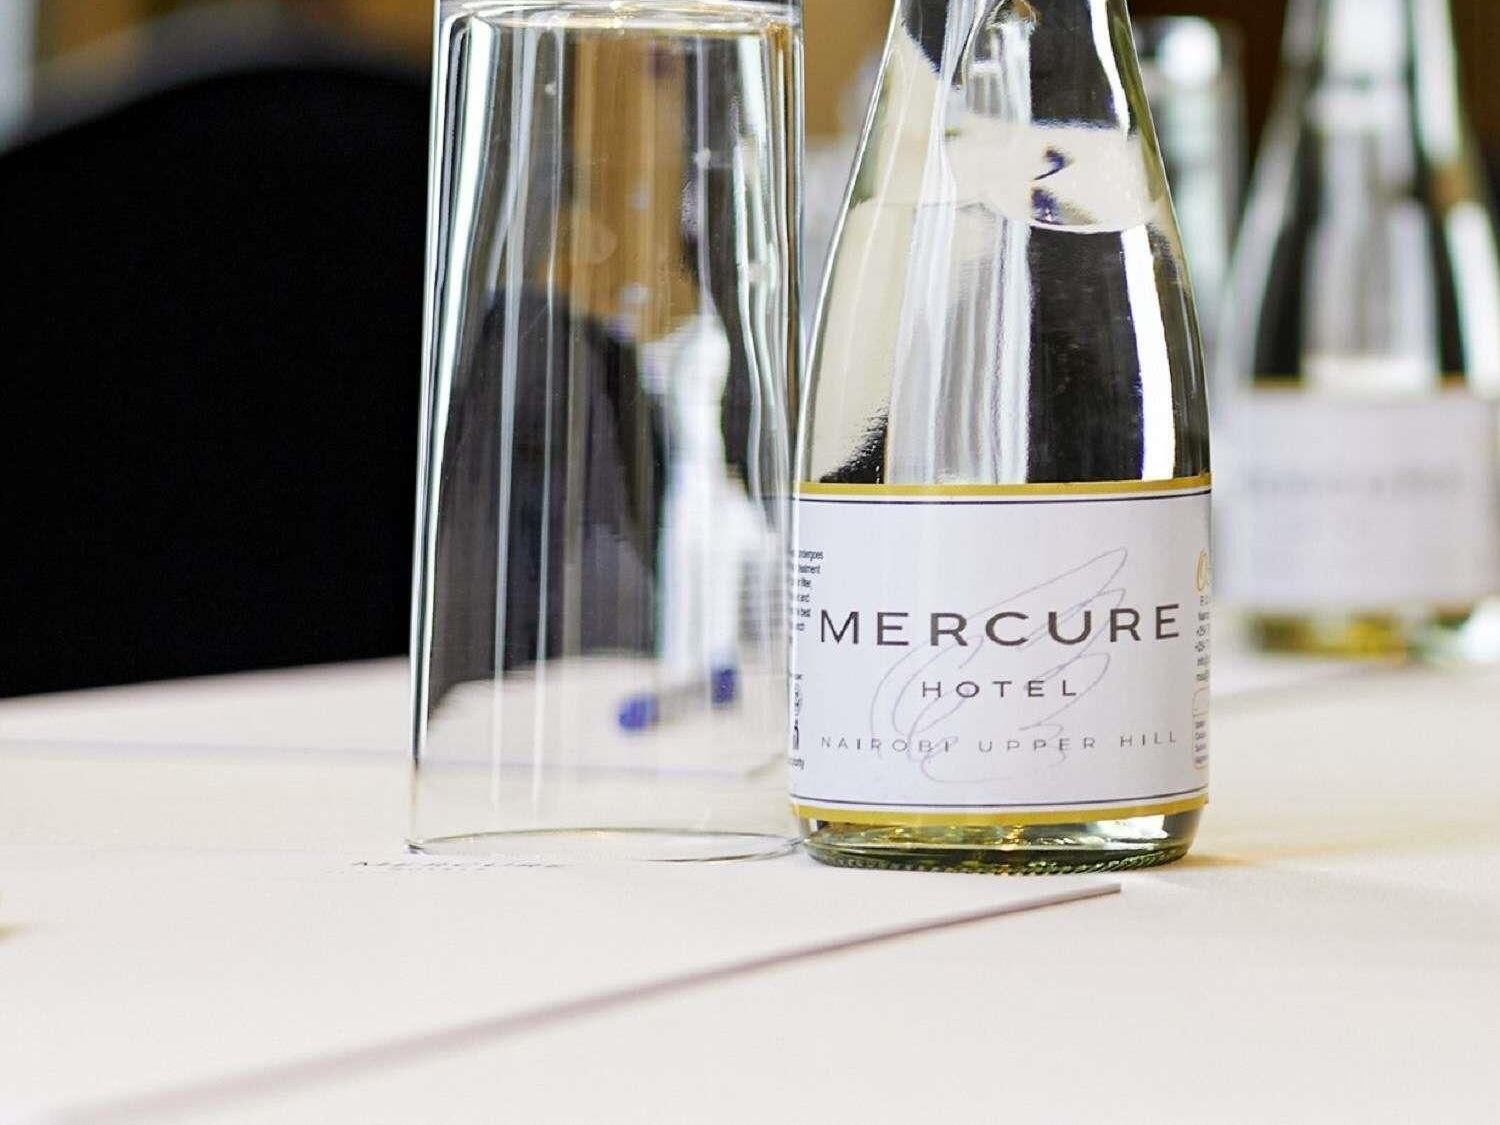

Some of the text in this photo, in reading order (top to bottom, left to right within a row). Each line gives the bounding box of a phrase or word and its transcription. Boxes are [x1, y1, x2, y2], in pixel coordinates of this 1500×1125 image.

[819, 603, 1180, 647] MERCURE
[921, 679, 1079, 698] HOTEL
[820, 730, 1178, 753] NAIROBI UPPER HILL
